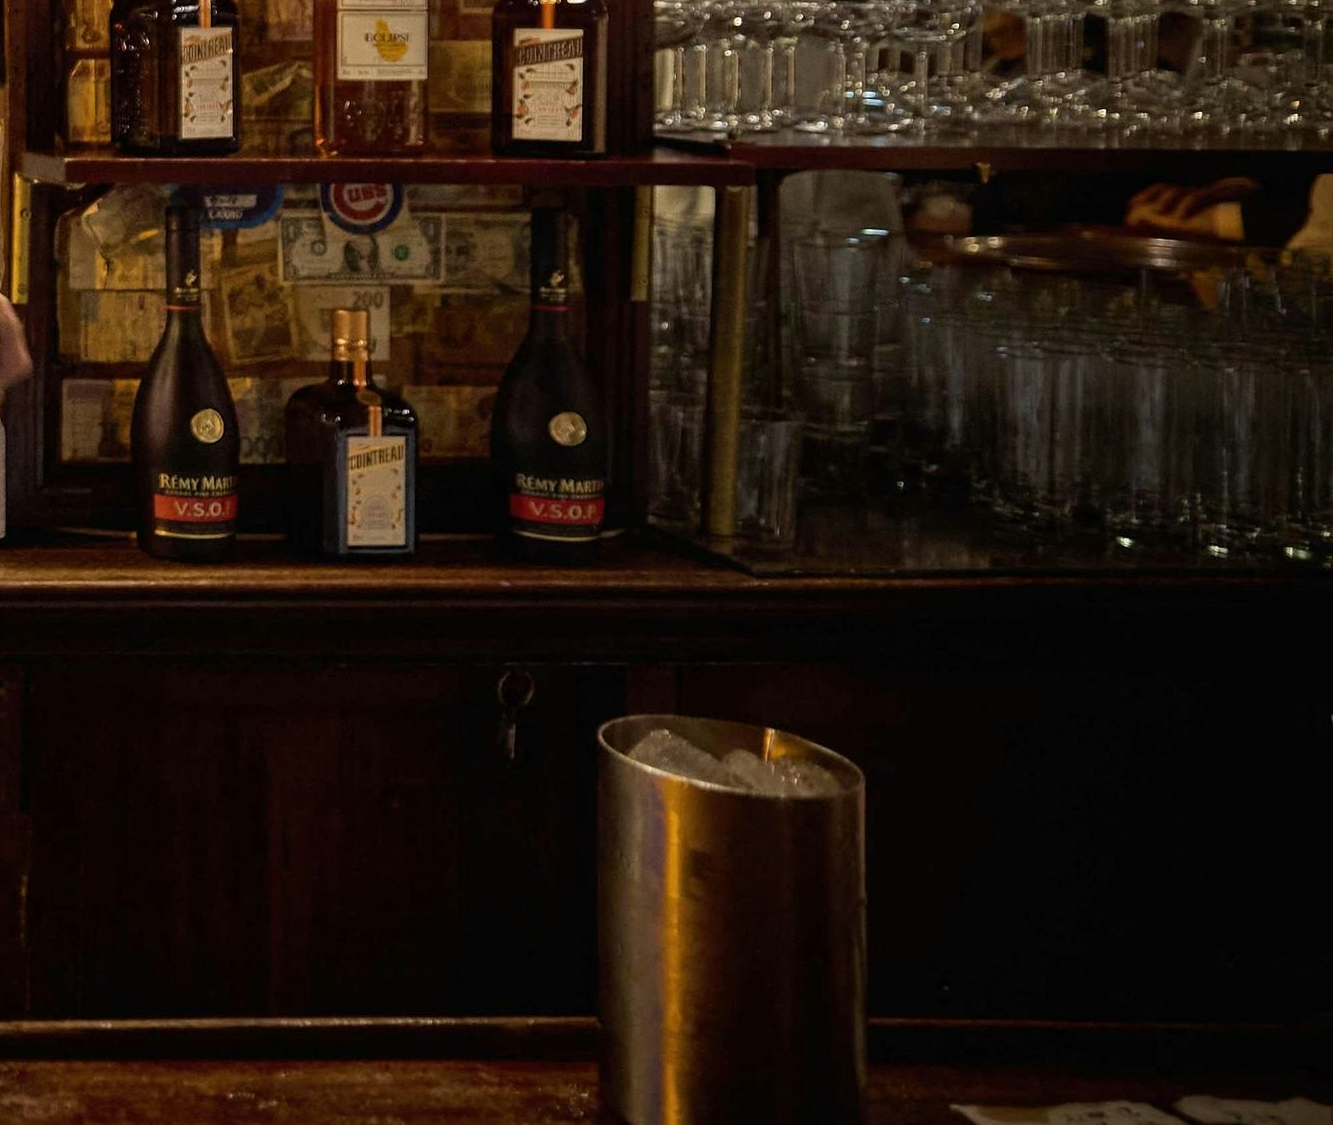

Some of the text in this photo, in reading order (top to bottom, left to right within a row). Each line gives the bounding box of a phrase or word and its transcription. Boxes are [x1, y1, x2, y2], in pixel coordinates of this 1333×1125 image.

[516, 37, 584, 66] COINTREAU
[348, 443, 407, 472] COINTREAU
[158, 472, 197, 492] RÉMY
